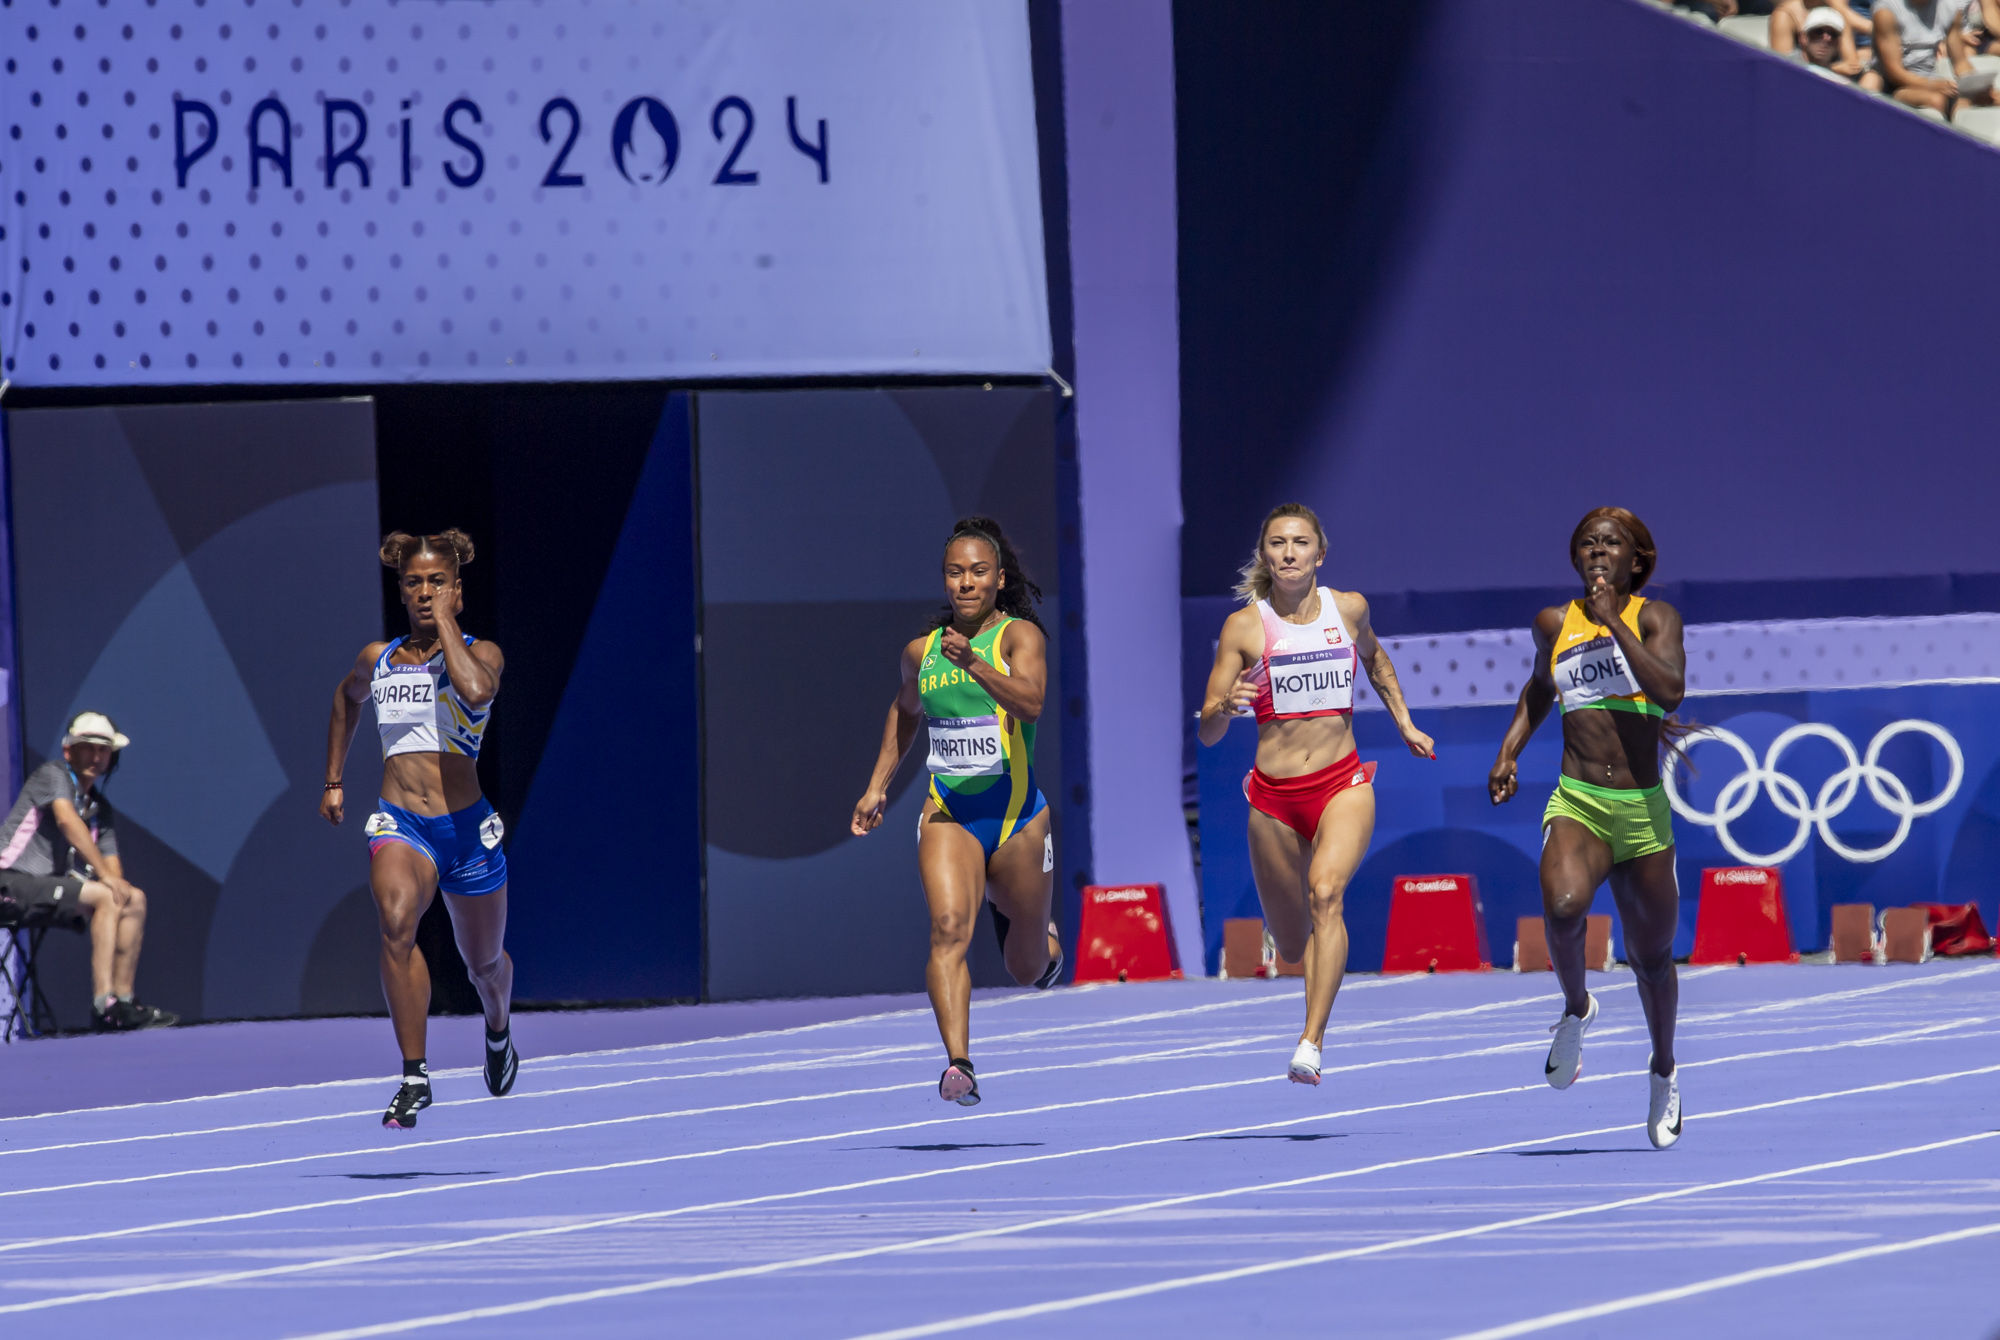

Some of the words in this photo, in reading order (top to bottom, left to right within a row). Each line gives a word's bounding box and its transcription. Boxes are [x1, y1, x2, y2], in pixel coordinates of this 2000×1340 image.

[538, 95, 831, 189] 2024
[1292, 654, 1314, 662] PARIS
[1315, 651, 1333, 659] 2024
[1274, 669, 1352, 694] KOTWILA
[1568, 656, 1625, 687] KONE
[374, 684, 432, 706] SUAREZ
[932, 737, 997, 757] MARTINS
